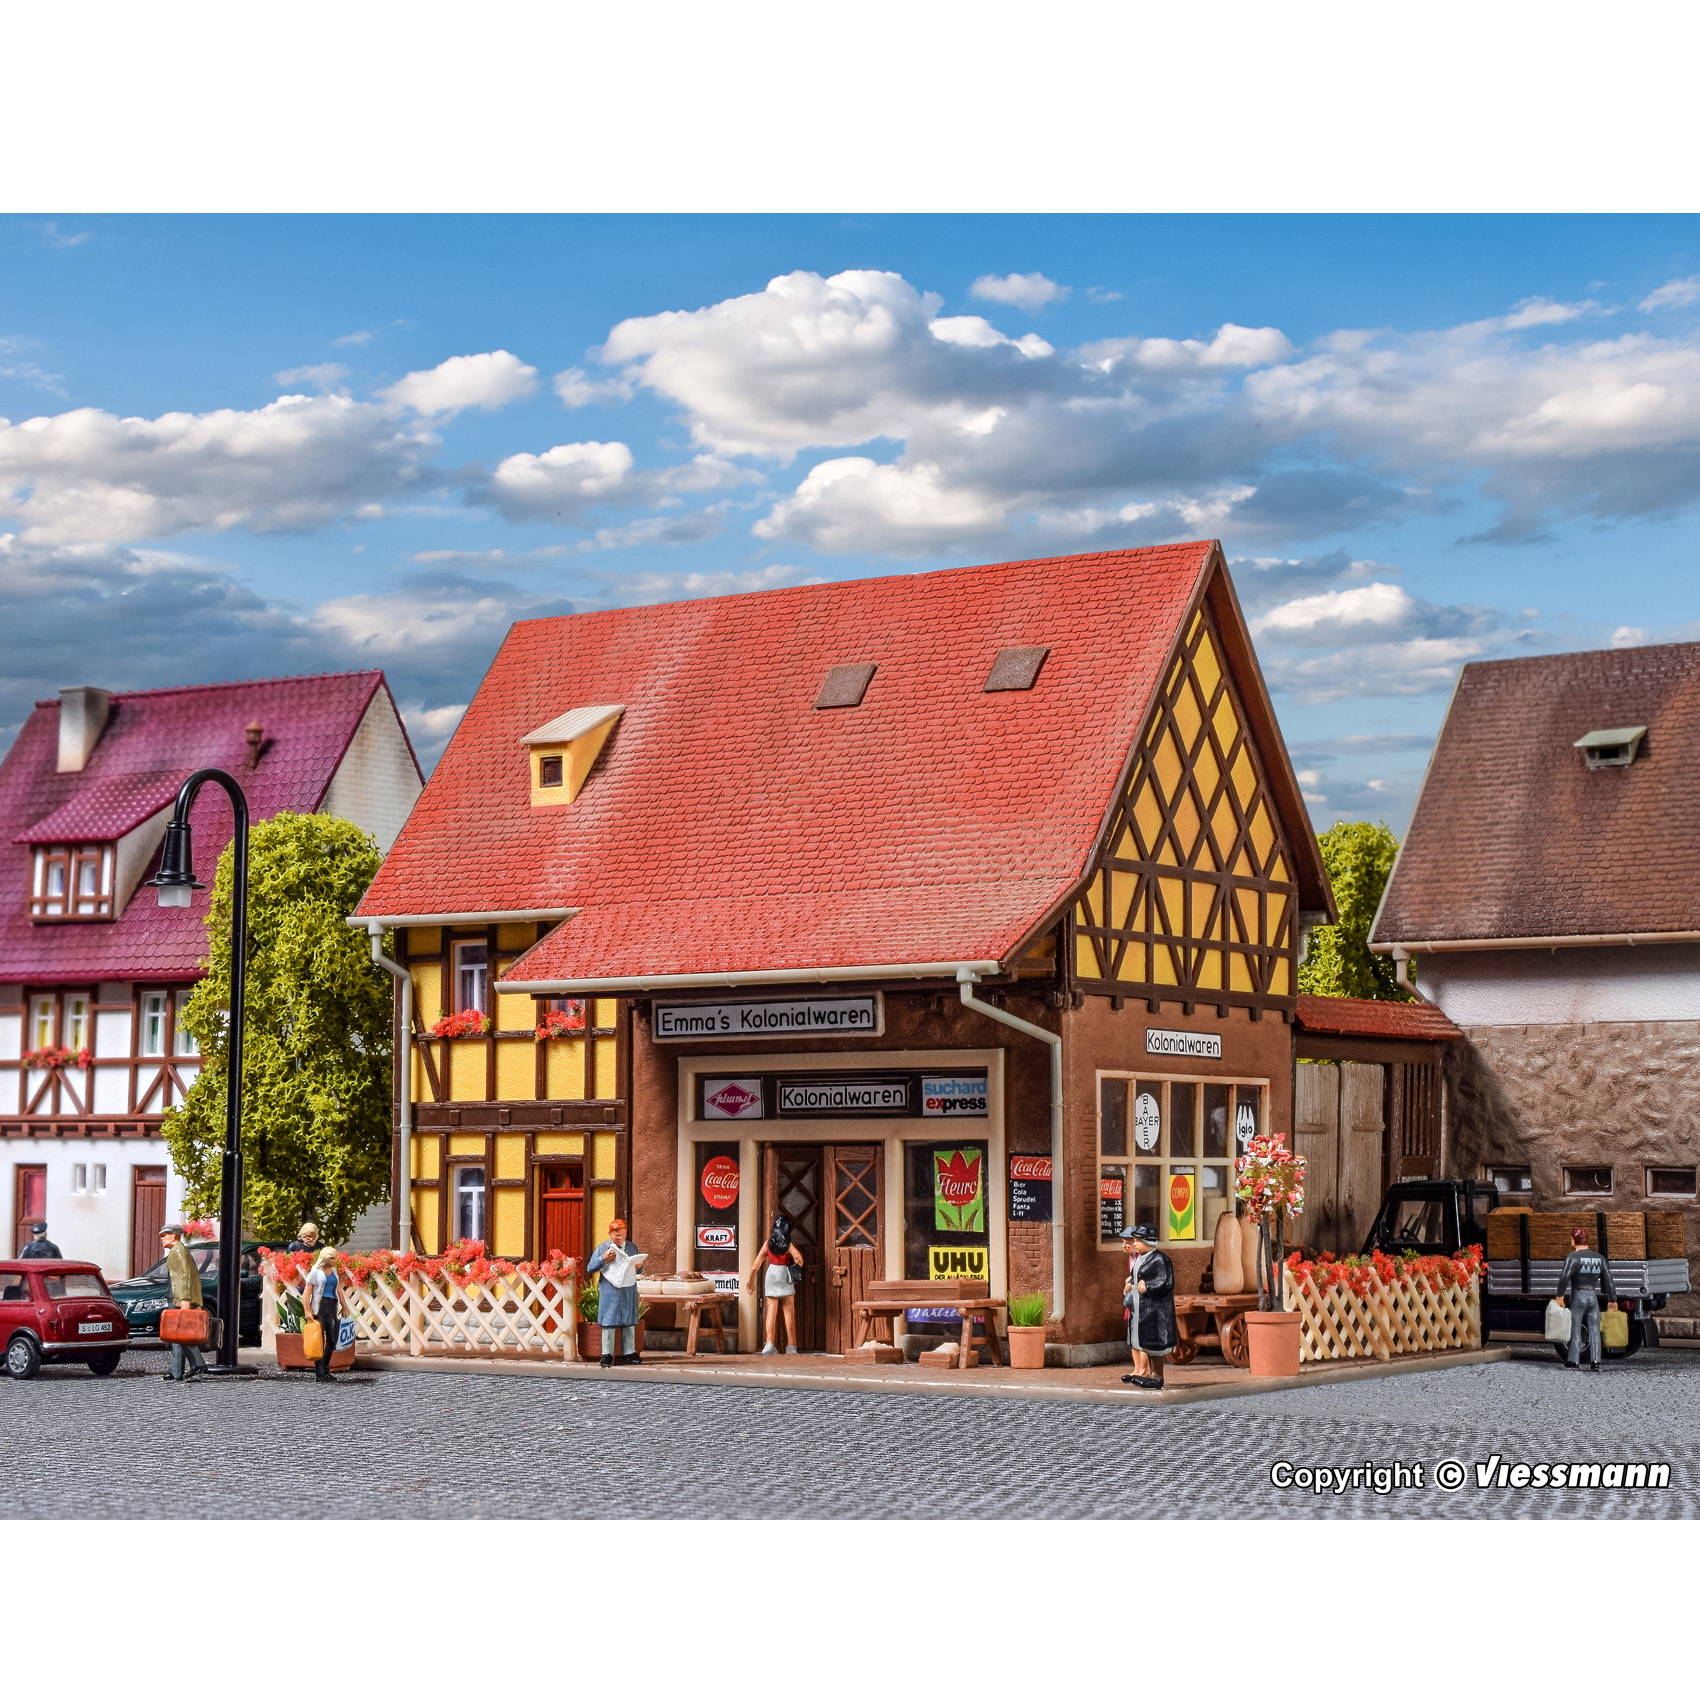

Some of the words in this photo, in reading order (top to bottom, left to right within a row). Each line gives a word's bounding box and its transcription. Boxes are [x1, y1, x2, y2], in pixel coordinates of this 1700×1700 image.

[661, 1009, 731, 1031] Emma's
[741, 1006, 871, 1028] Kolonialwaren
[1147, 1031, 1220, 1055] Kolonialwaren
[924, 1079, 987, 1095] suchard
[783, 1086, 904, 1107] Kolonialwaren
[925, 1097, 987, 1114] express
[1238, 1123, 1253, 1138] iglo
[1013, 1195, 1036, 1203] Sprudel
[705, 1234, 728, 1242] KRAFT
[933, 1251, 984, 1274] UHU
